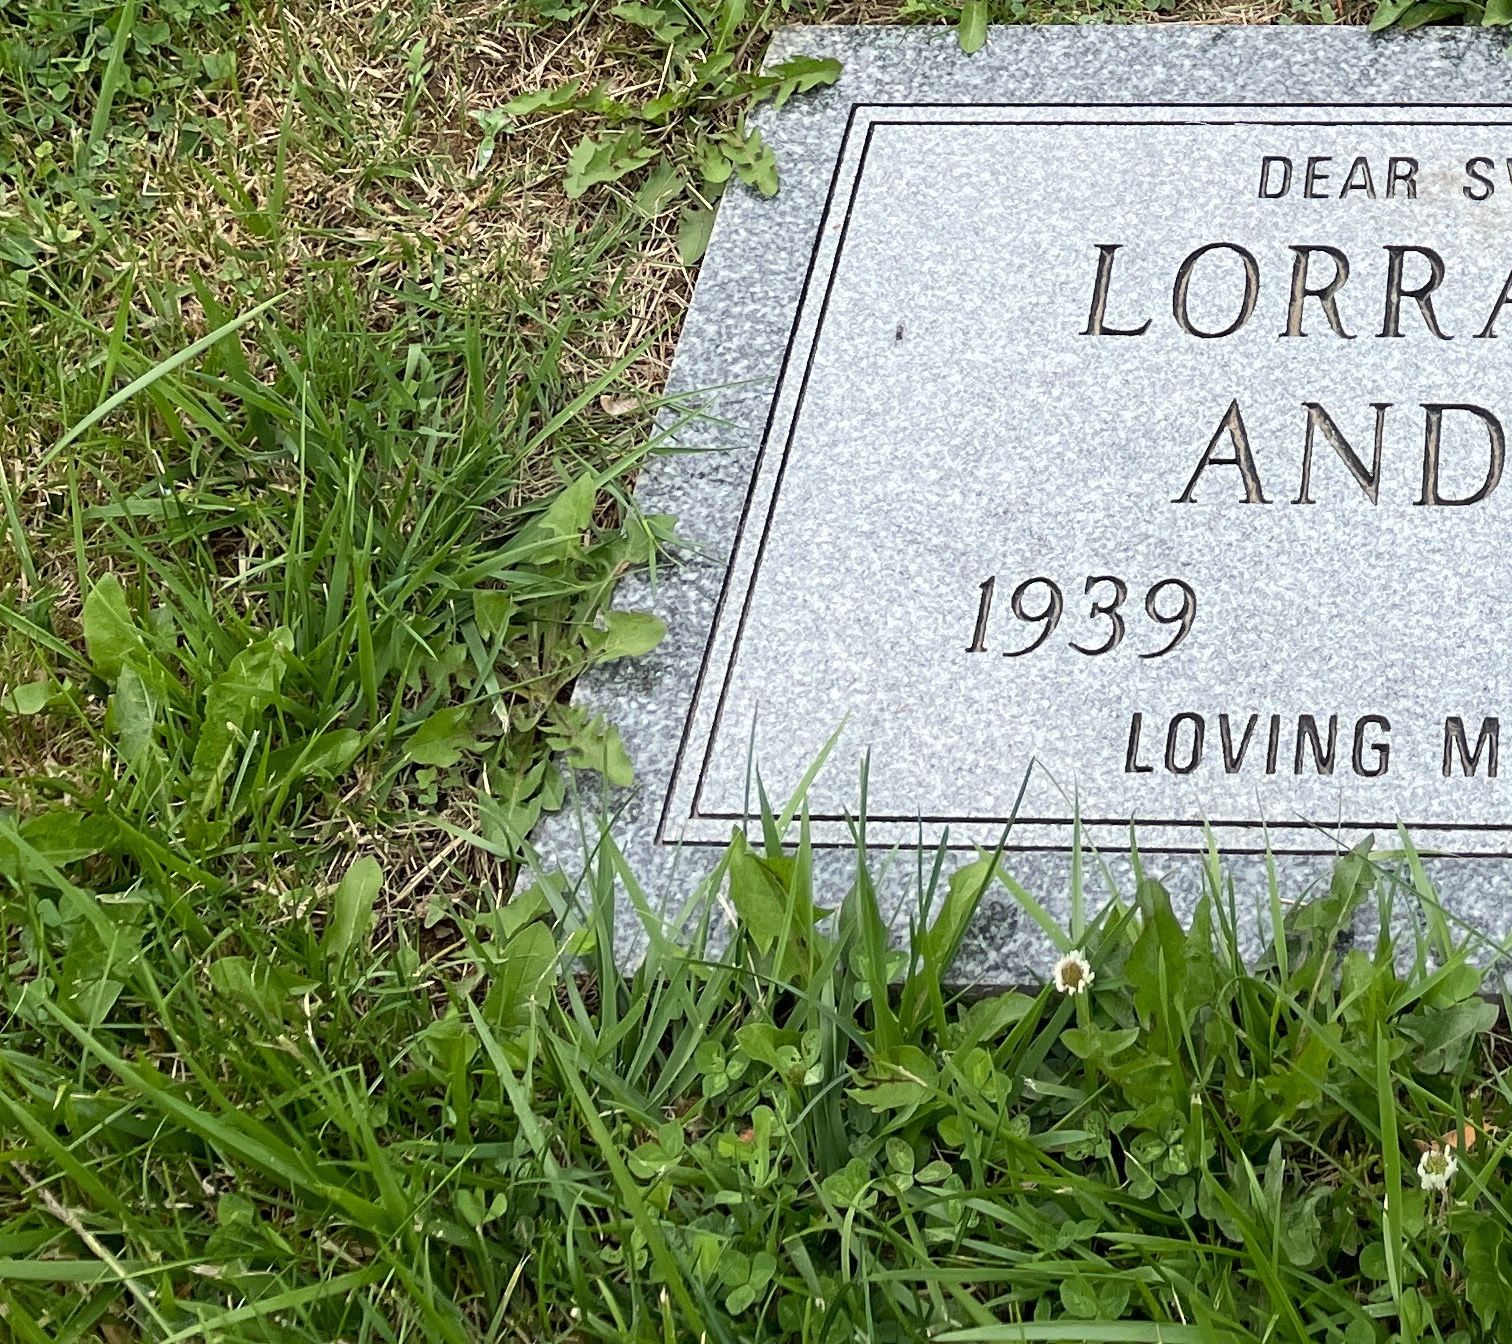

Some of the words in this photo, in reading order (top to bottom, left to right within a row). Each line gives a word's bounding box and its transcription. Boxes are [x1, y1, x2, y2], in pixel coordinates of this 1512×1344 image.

[1257, 155, 1419, 200] DEAR
[963, 575, 1197, 660] 1939
[1123, 711, 1392, 778] LOVING
